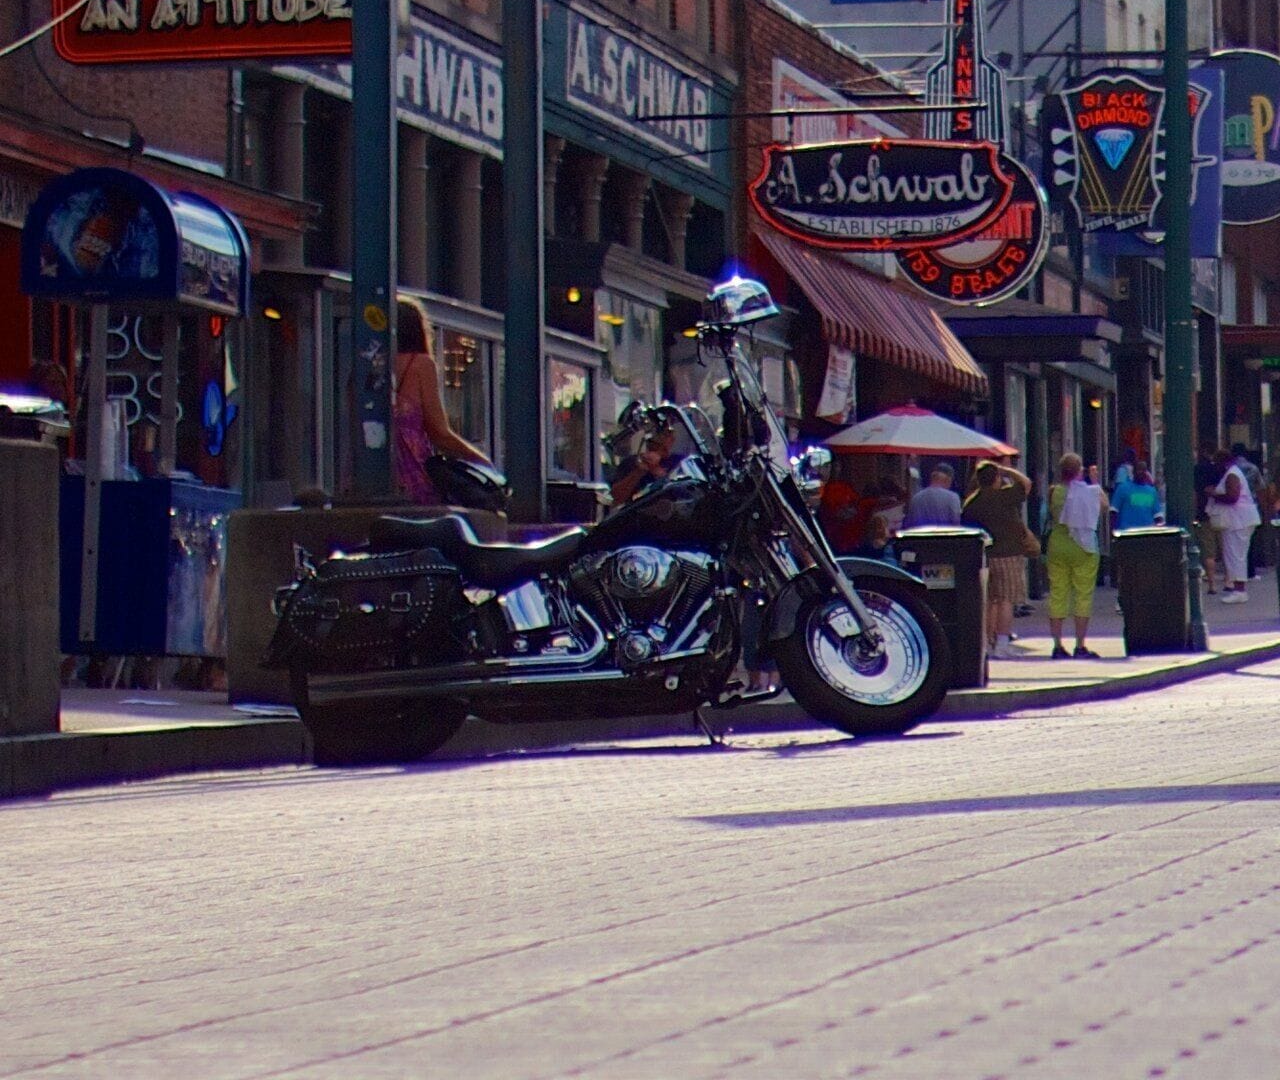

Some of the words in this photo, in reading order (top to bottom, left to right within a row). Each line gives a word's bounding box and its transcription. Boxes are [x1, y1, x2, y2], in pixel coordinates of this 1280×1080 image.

[396, 34, 503, 140] HWAB
[1081, 92, 1148, 108] BLACK
[1077, 107, 1152, 129] DIAMOND
[819, 152, 990, 204] Schwab
[808, 216, 924, 236] ESTABLISHED
[951, 245, 1026, 295] BEALE
